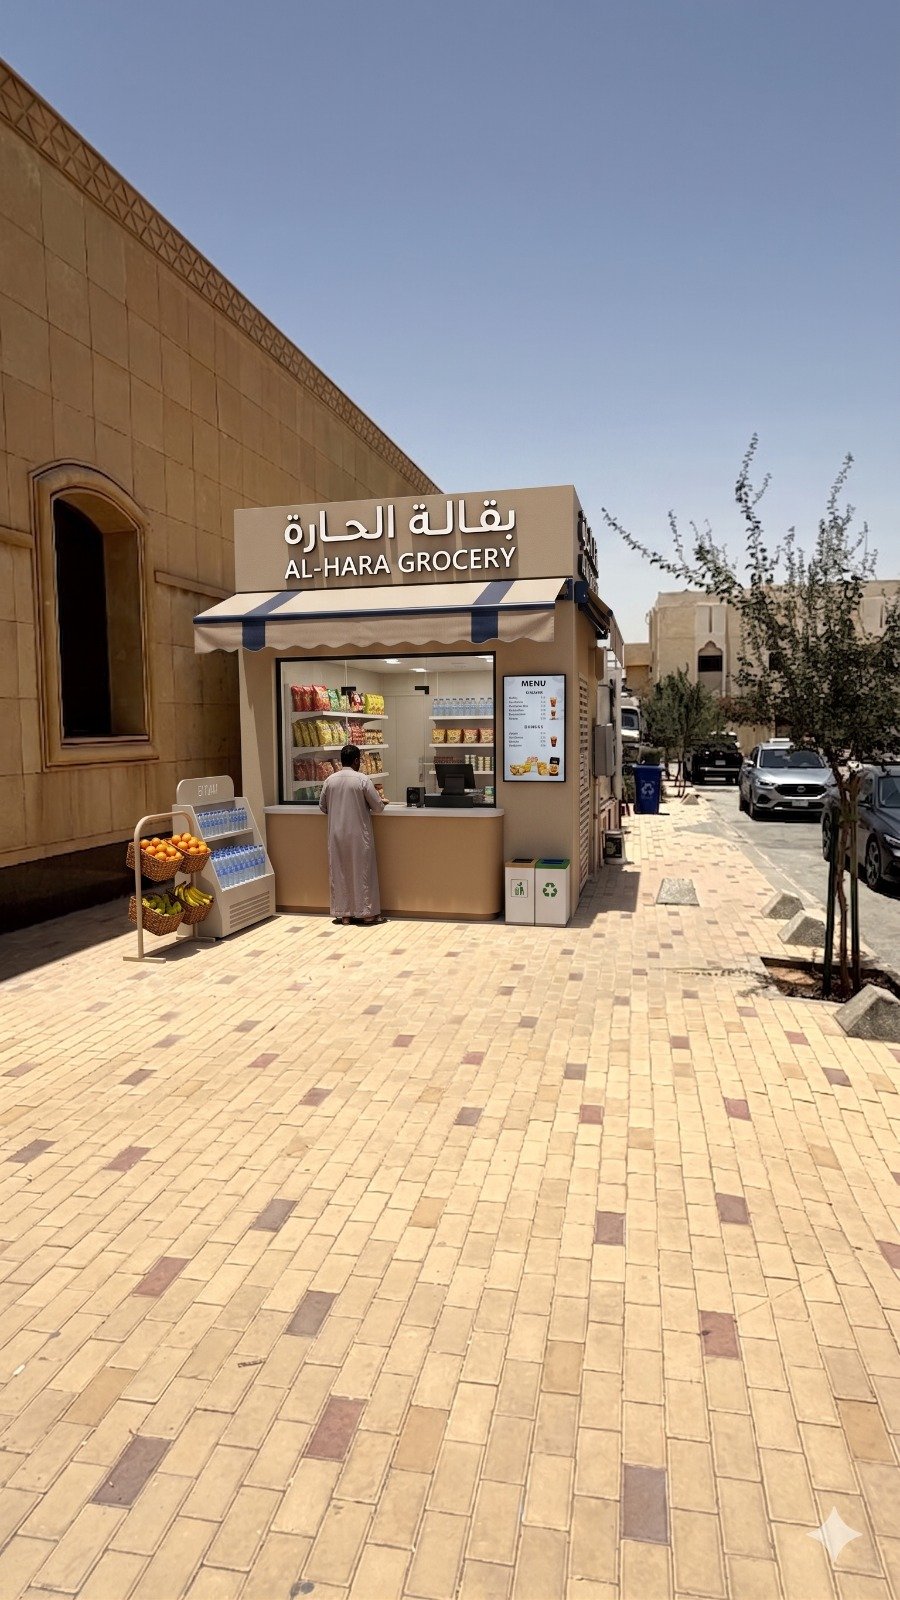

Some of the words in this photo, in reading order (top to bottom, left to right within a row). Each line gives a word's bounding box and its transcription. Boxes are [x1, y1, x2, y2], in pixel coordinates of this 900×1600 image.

[284, 504, 395, 553] الحارة
[409, 499, 516, 541] بقالة
[284, 554, 391, 580] AL-HARA
[398, 546, 516, 574] GROCERY
